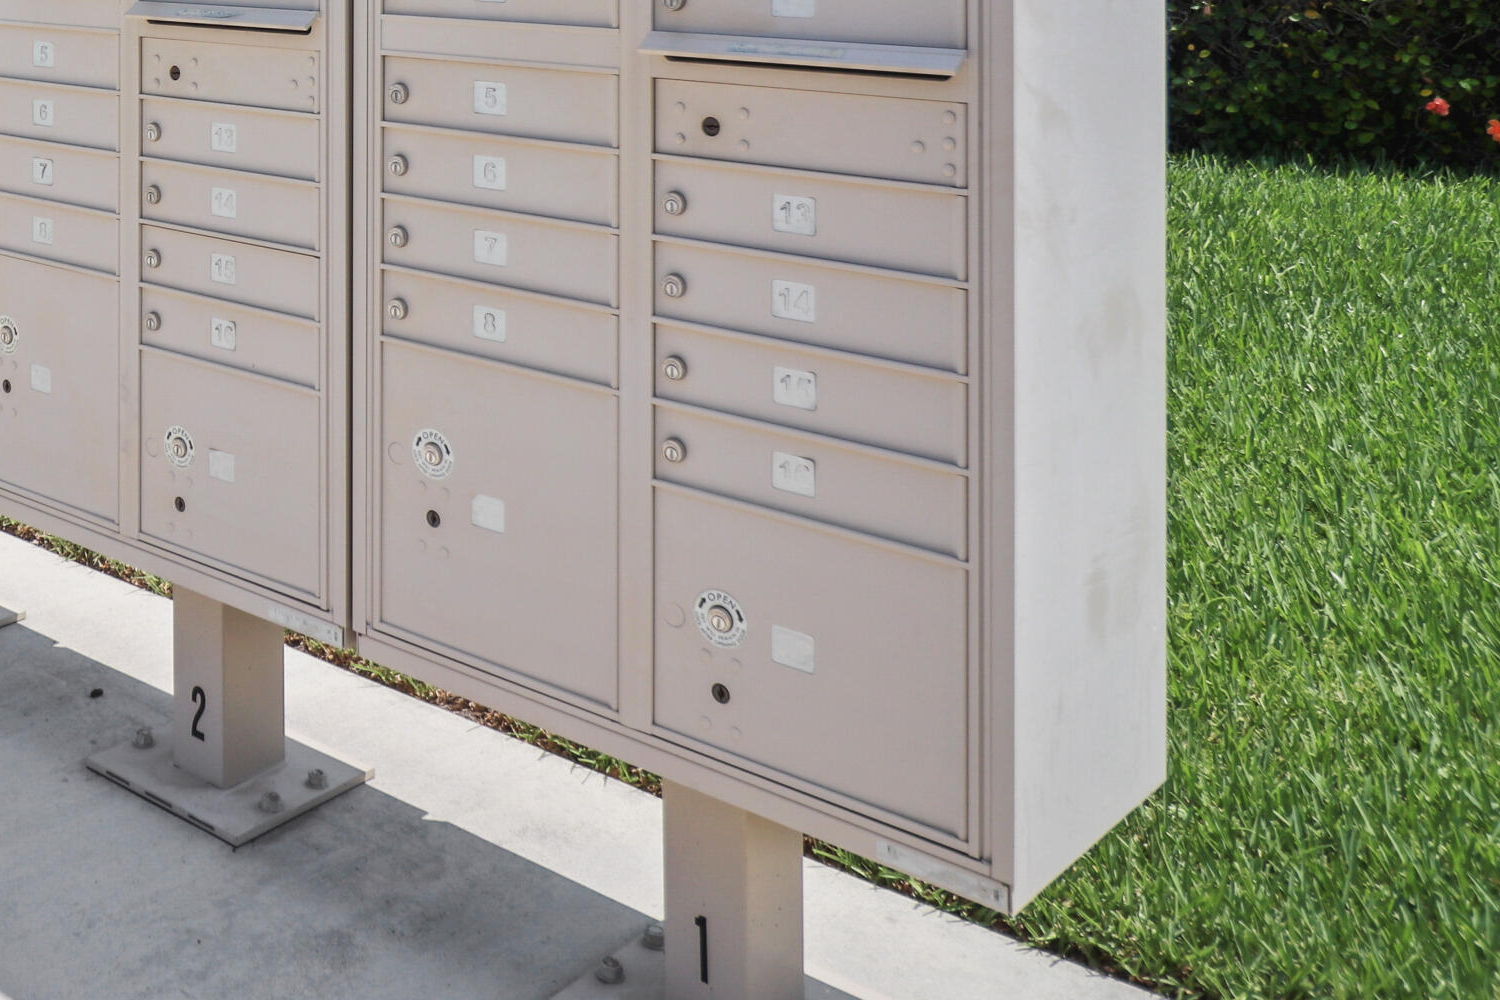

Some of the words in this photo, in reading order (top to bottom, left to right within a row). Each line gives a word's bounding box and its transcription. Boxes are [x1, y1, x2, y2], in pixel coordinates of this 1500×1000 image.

[39, 45, 48, 62] 5
[484, 87, 497, 108] 5
[39, 104, 47, 120] 6
[214, 127, 235, 147] 13
[39, 163, 48, 179] 7
[483, 162, 496, 183] 6
[214, 191, 234, 211] 14
[39, 222, 47, 237] 8
[484, 237, 497, 256] 7
[215, 258, 234, 279] 15
[778, 287, 810, 314] 14
[483, 312, 496, 333] 8
[172, 427, 189, 440] OPEN
[422, 431, 445, 445] OPEN
[707, 592, 737, 610] OPEN
[191, 686, 206, 742] 2
[694, 915, 708, 984] 1
